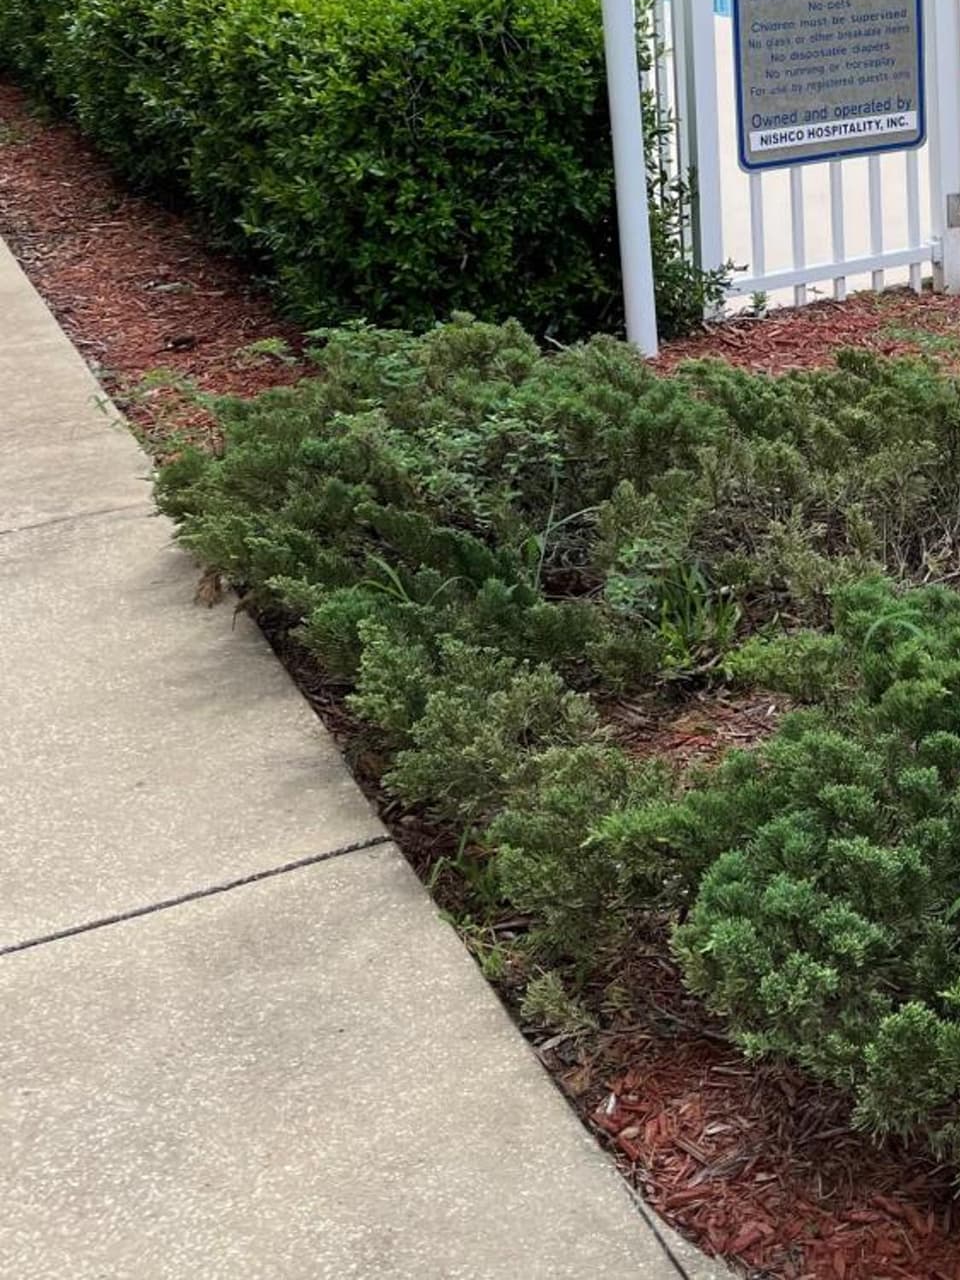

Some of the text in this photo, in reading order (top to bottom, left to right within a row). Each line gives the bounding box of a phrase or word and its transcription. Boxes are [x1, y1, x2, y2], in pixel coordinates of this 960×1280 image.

[808, 1, 824, 12] No
[751, 9, 907, 33] Children must be supervised
[771, 52, 785, 62] No
[790, 48, 847, 61] disposable
[765, 70, 780, 79] No
[751, 93, 912, 128] Owned and operated by
[760, 116, 909, 146] NISHCO HOSPITALITY, INC.
